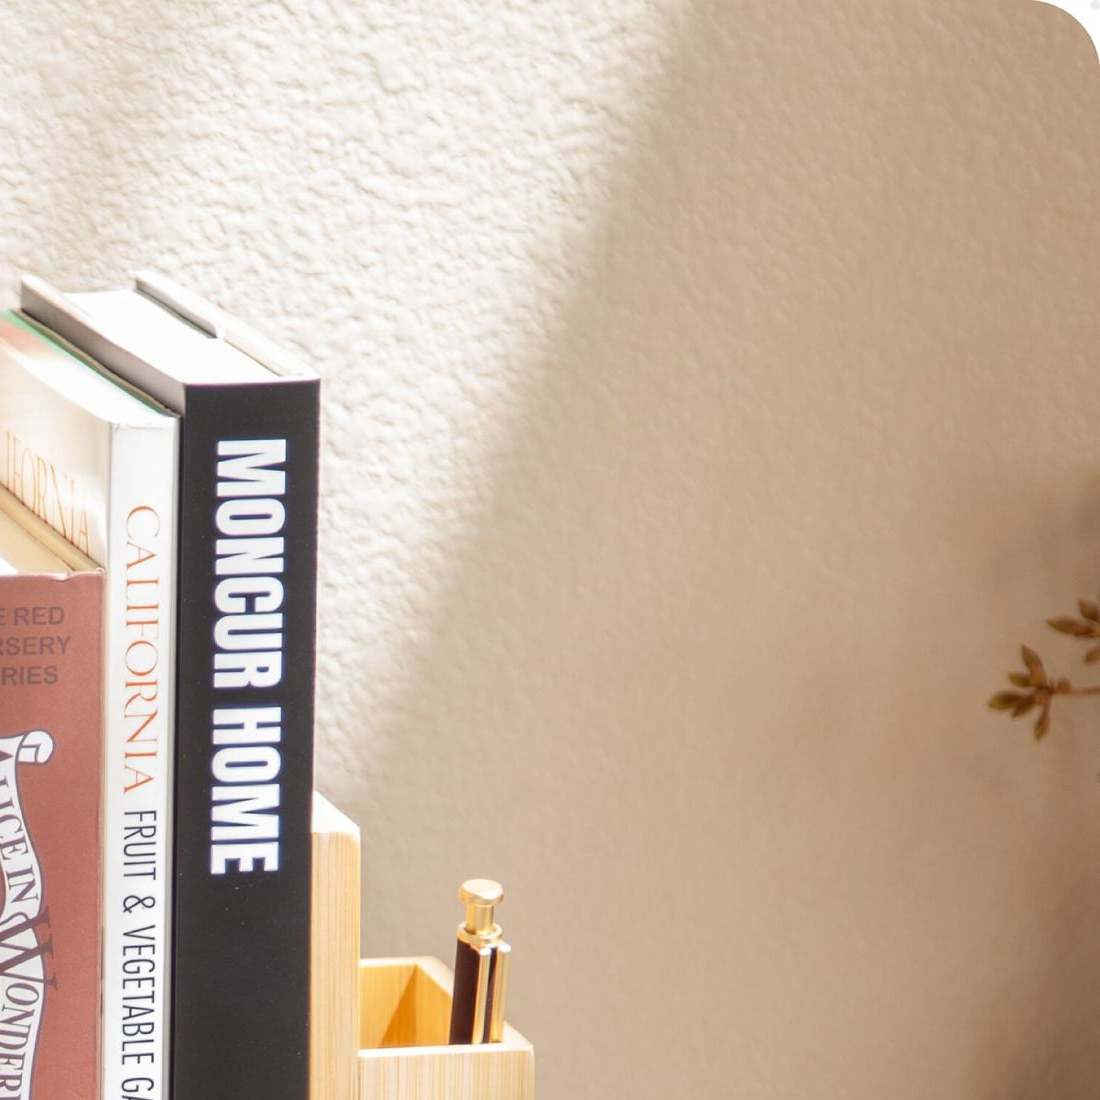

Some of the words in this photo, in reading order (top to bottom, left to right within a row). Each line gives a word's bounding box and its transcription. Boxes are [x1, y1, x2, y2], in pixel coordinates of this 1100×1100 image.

[14, 607, 65, 626] RED
[213, 438, 287, 689] MONCUR
[124, 505, 159, 793] CALIFORNIA
[210, 706, 281, 875] HOME
[7, 865, 39, 904] IN
[123, 810, 157, 881] FRUIT
[122, 894, 156, 914] &
[121, 924, 156, 1065] VEGETABLE
